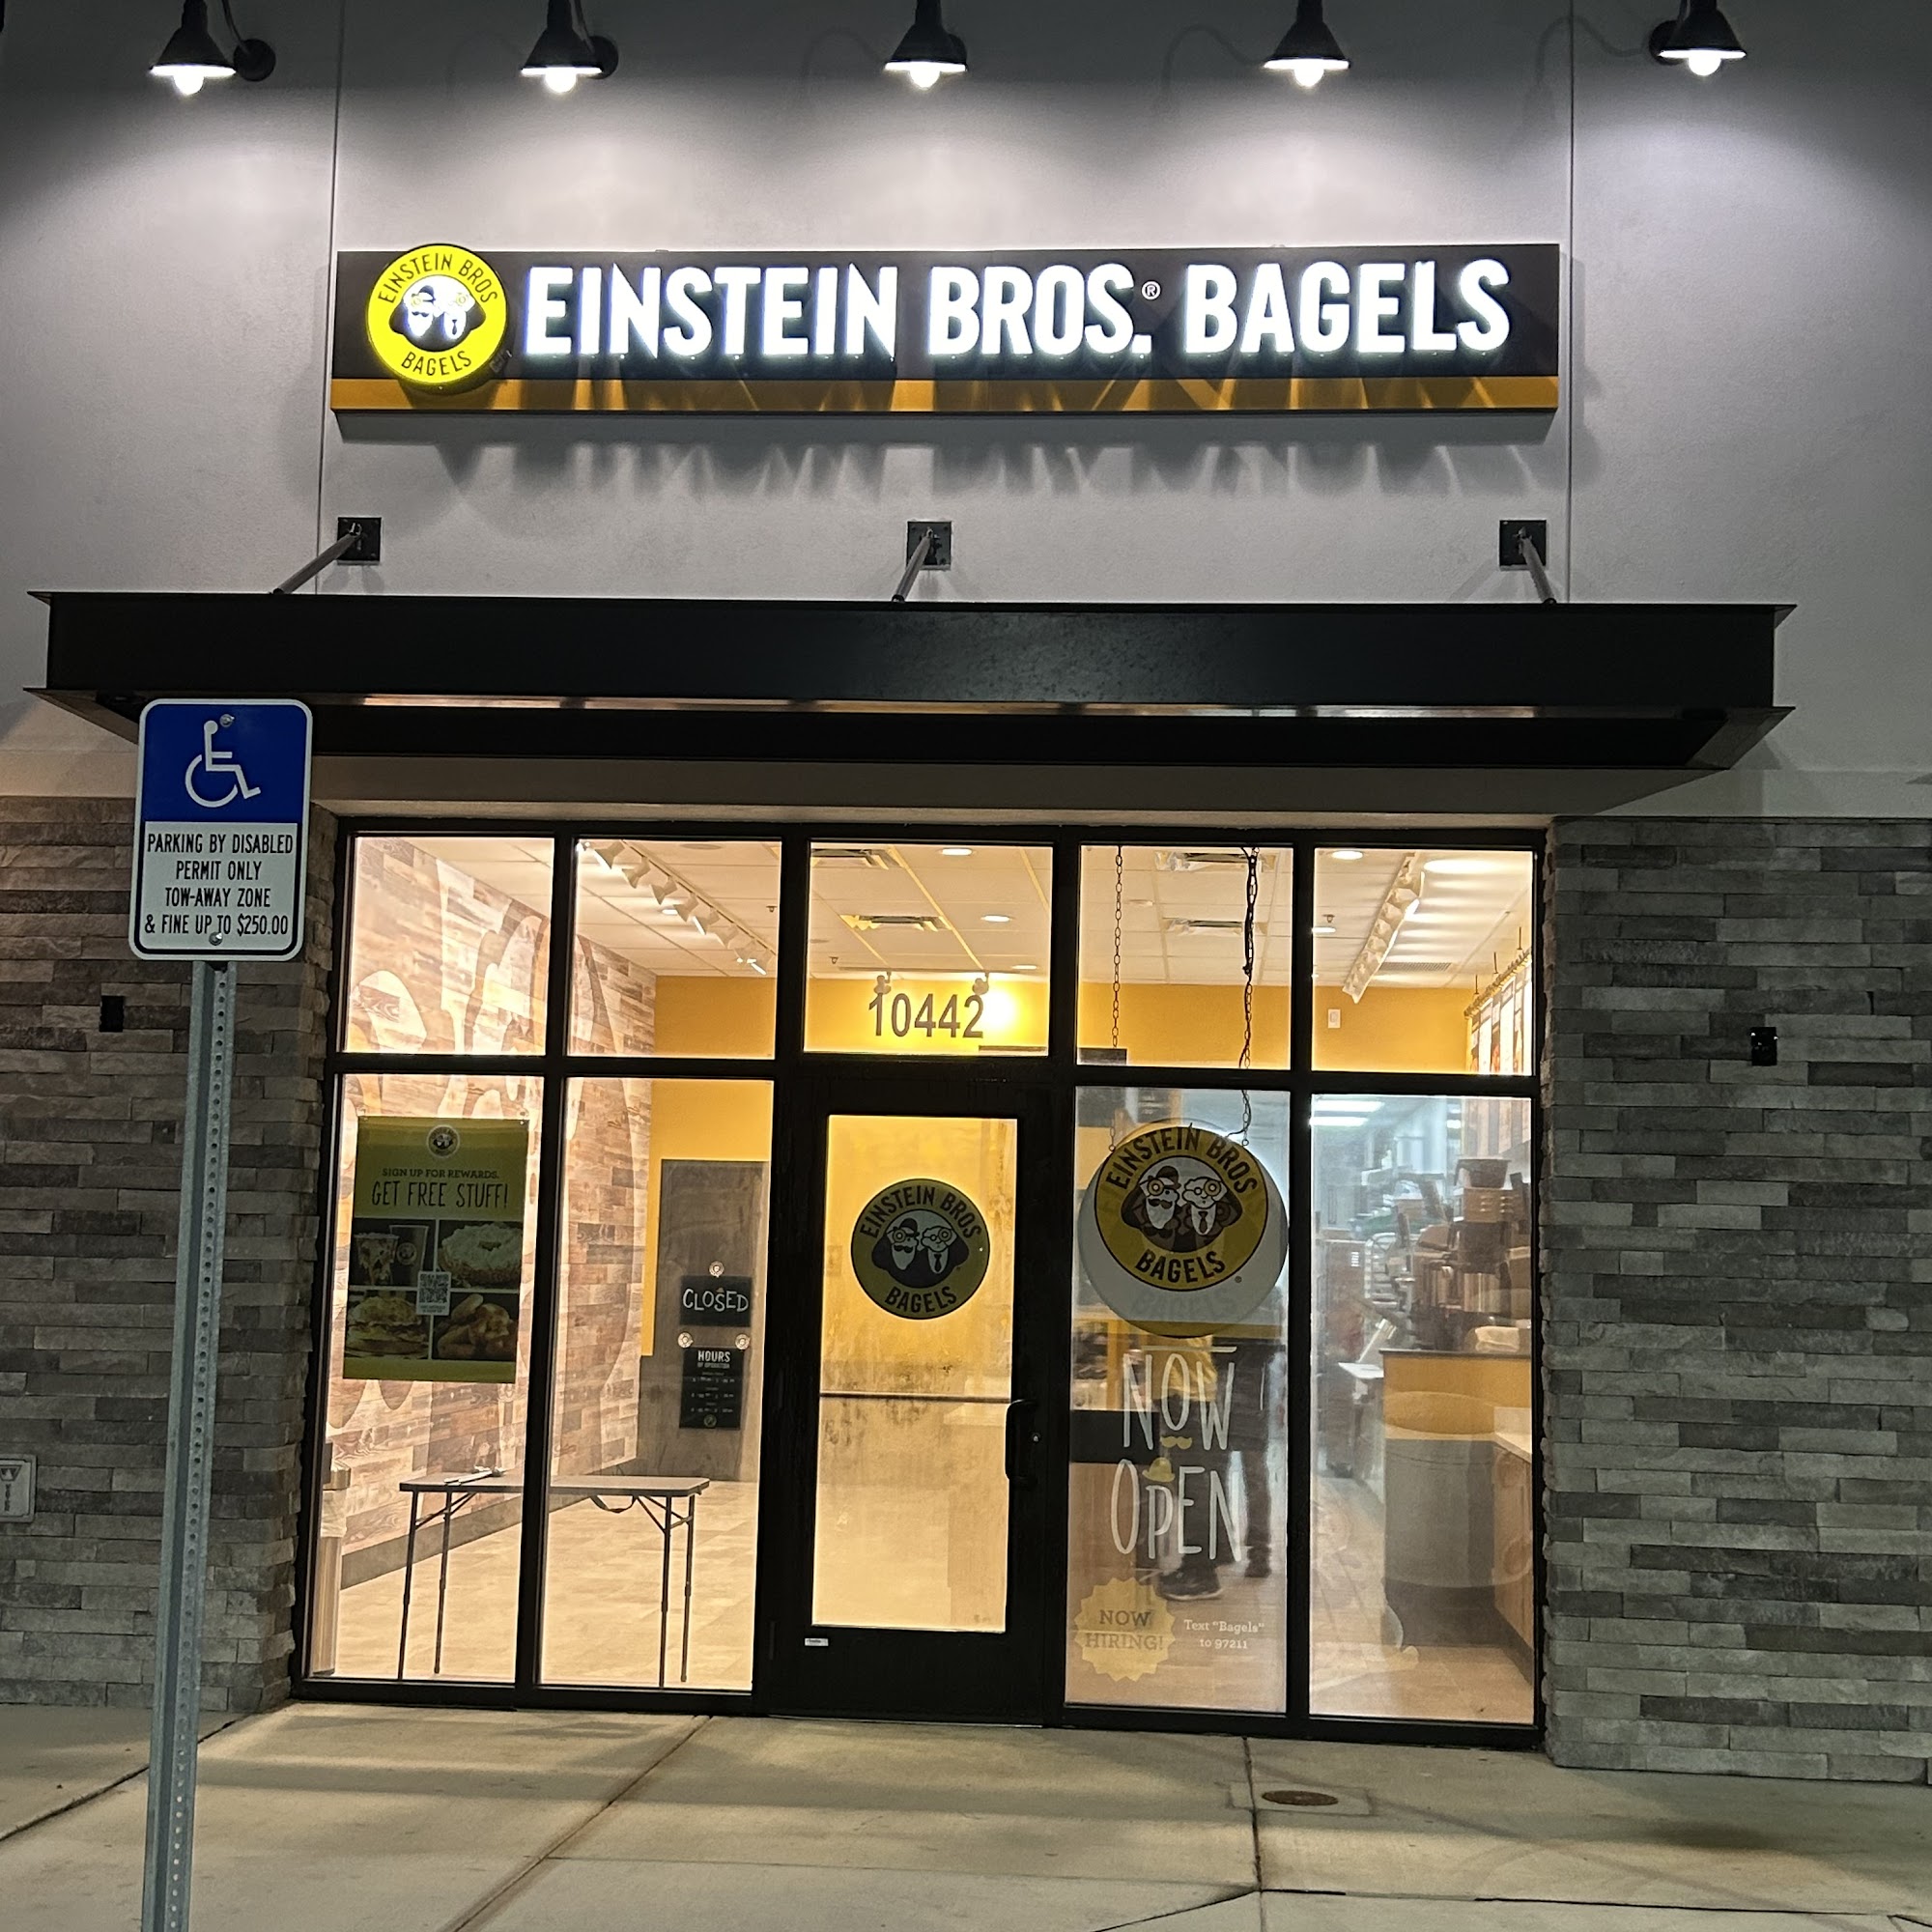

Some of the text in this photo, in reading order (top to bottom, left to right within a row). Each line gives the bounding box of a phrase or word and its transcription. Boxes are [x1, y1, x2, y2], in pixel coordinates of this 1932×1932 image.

[378, 253, 498, 303] EINSTEIN BROS
[525, 263, 898, 359] EINSTEIN
[1185, 258, 1511, 354] BAGELS
[401, 351, 471, 376] BAGELS
[147, 834, 294, 854] PARKING BY DISABLED
[176, 860, 262, 881] PERMIT ONLY
[165, 887, 270, 908] TOW-AWAY ZONE
[145, 913, 289, 936] & FINE UP TO $250.00
[868, 992, 983, 1038] 10442
[1105, 1127, 1257, 1193] EINSTEIN BROS
[382, 1168, 408, 1177] SIGN
[410, 1169, 423, 1178] UP
[426, 1169, 445, 1178] FOR
[372, 1180, 509, 1208] GET FREE STUFF!
[860, 1185, 982, 1238] EINSTEIN BROS
[1135, 1249, 1226, 1283] BAGELS
[683, 1288, 749, 1312] CLOSED
[885, 1286, 956, 1313] BAGELS
[697, 1350, 730, 1362] HOURS
[1122, 1352, 1235, 1450] NOW
[1110, 1459, 1242, 1562] OPEN
[1099, 1609, 1151, 1627] NOW
[1183, 1619, 1209, 1632] Text
[1086, 1633, 1164, 1651] HIRING!
[1200, 1639, 1248, 1649] to 97211
